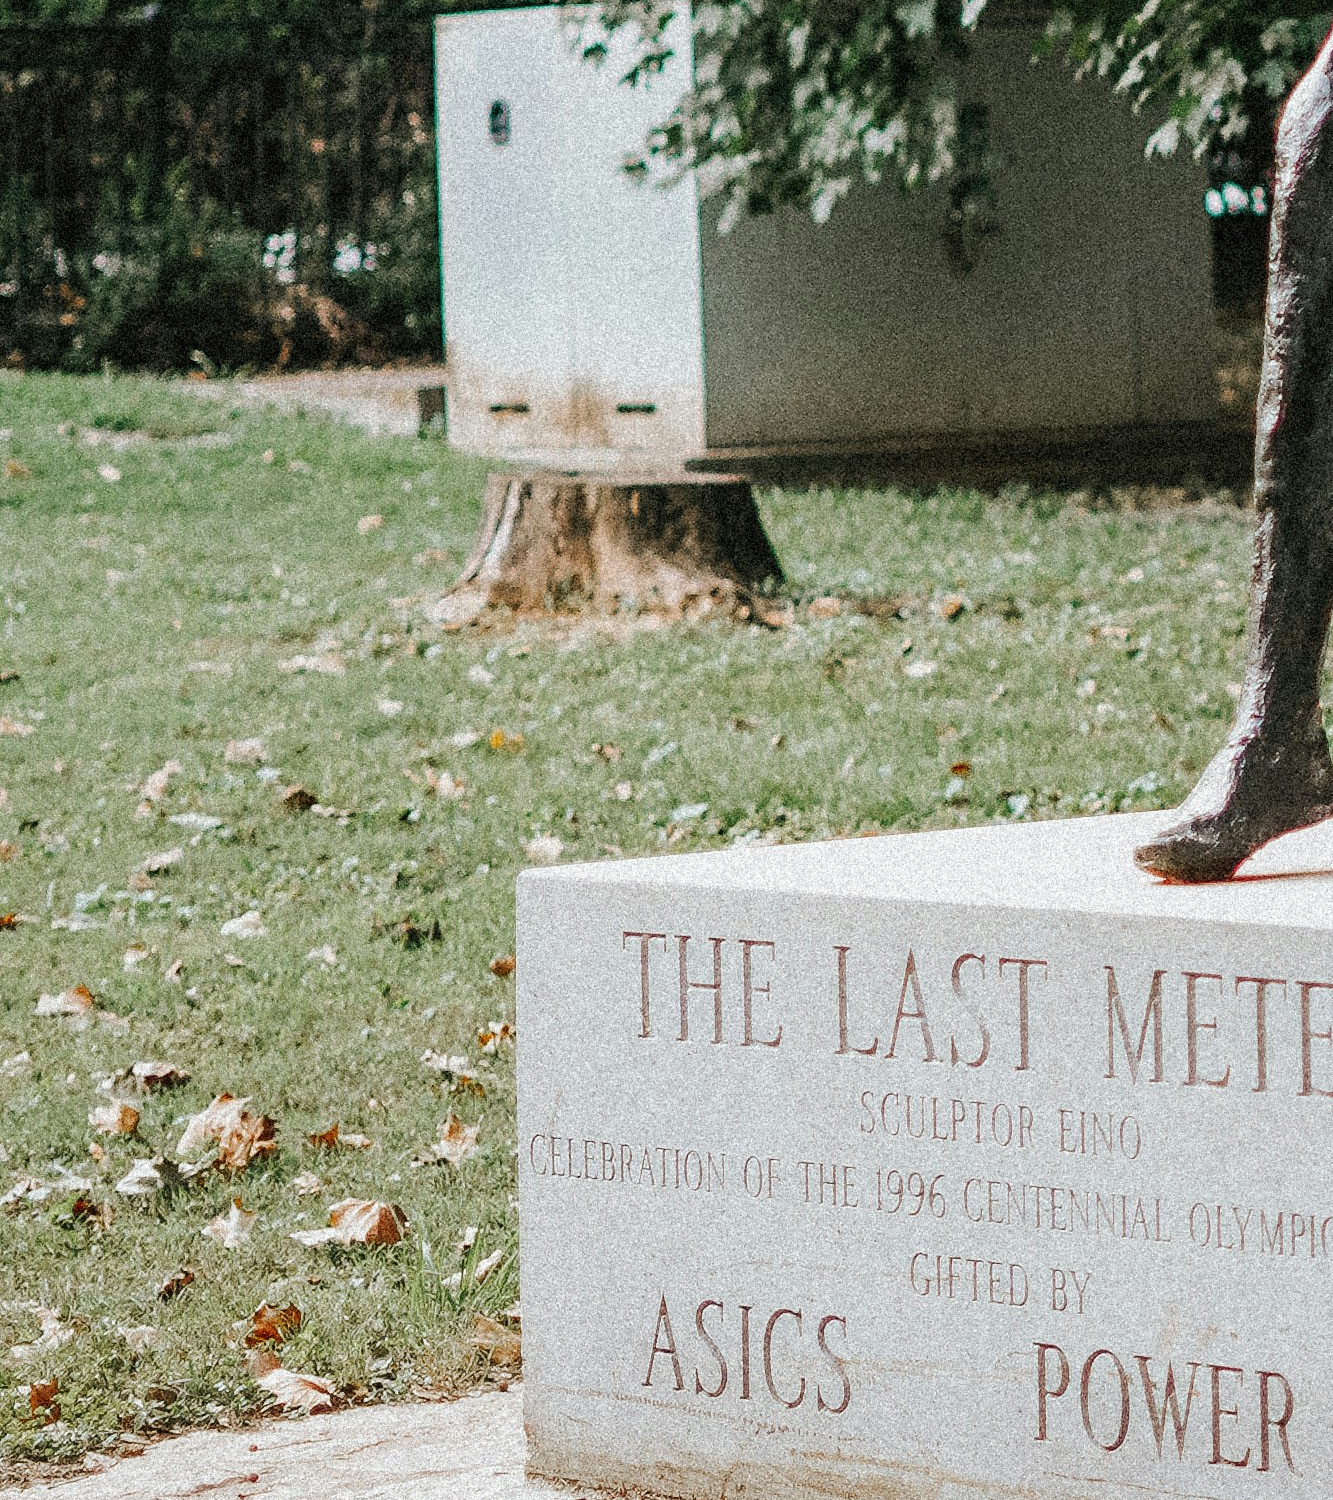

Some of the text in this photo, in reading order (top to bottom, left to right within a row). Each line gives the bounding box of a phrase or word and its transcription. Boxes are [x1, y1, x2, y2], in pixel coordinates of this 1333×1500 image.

[623, 931, 784, 1047] THE
[833, 945, 1048, 1072] LAST
[859, 1091, 1142, 1160] SCULPTOR EINO
[529, 1134, 728, 1192] CELEBRATION
[742, 1157, 783, 1200] OF
[797, 1161, 861, 1206] THE
[875, 1168, 946, 1220] 1996
[963, 1177, 1174, 1243] CENTENNIAL
[910, 1252, 1091, 1315] GIFTED BY
[641, 1295, 853, 1414] ASICS
[1032, 1341, 1302, 1478] POWER
